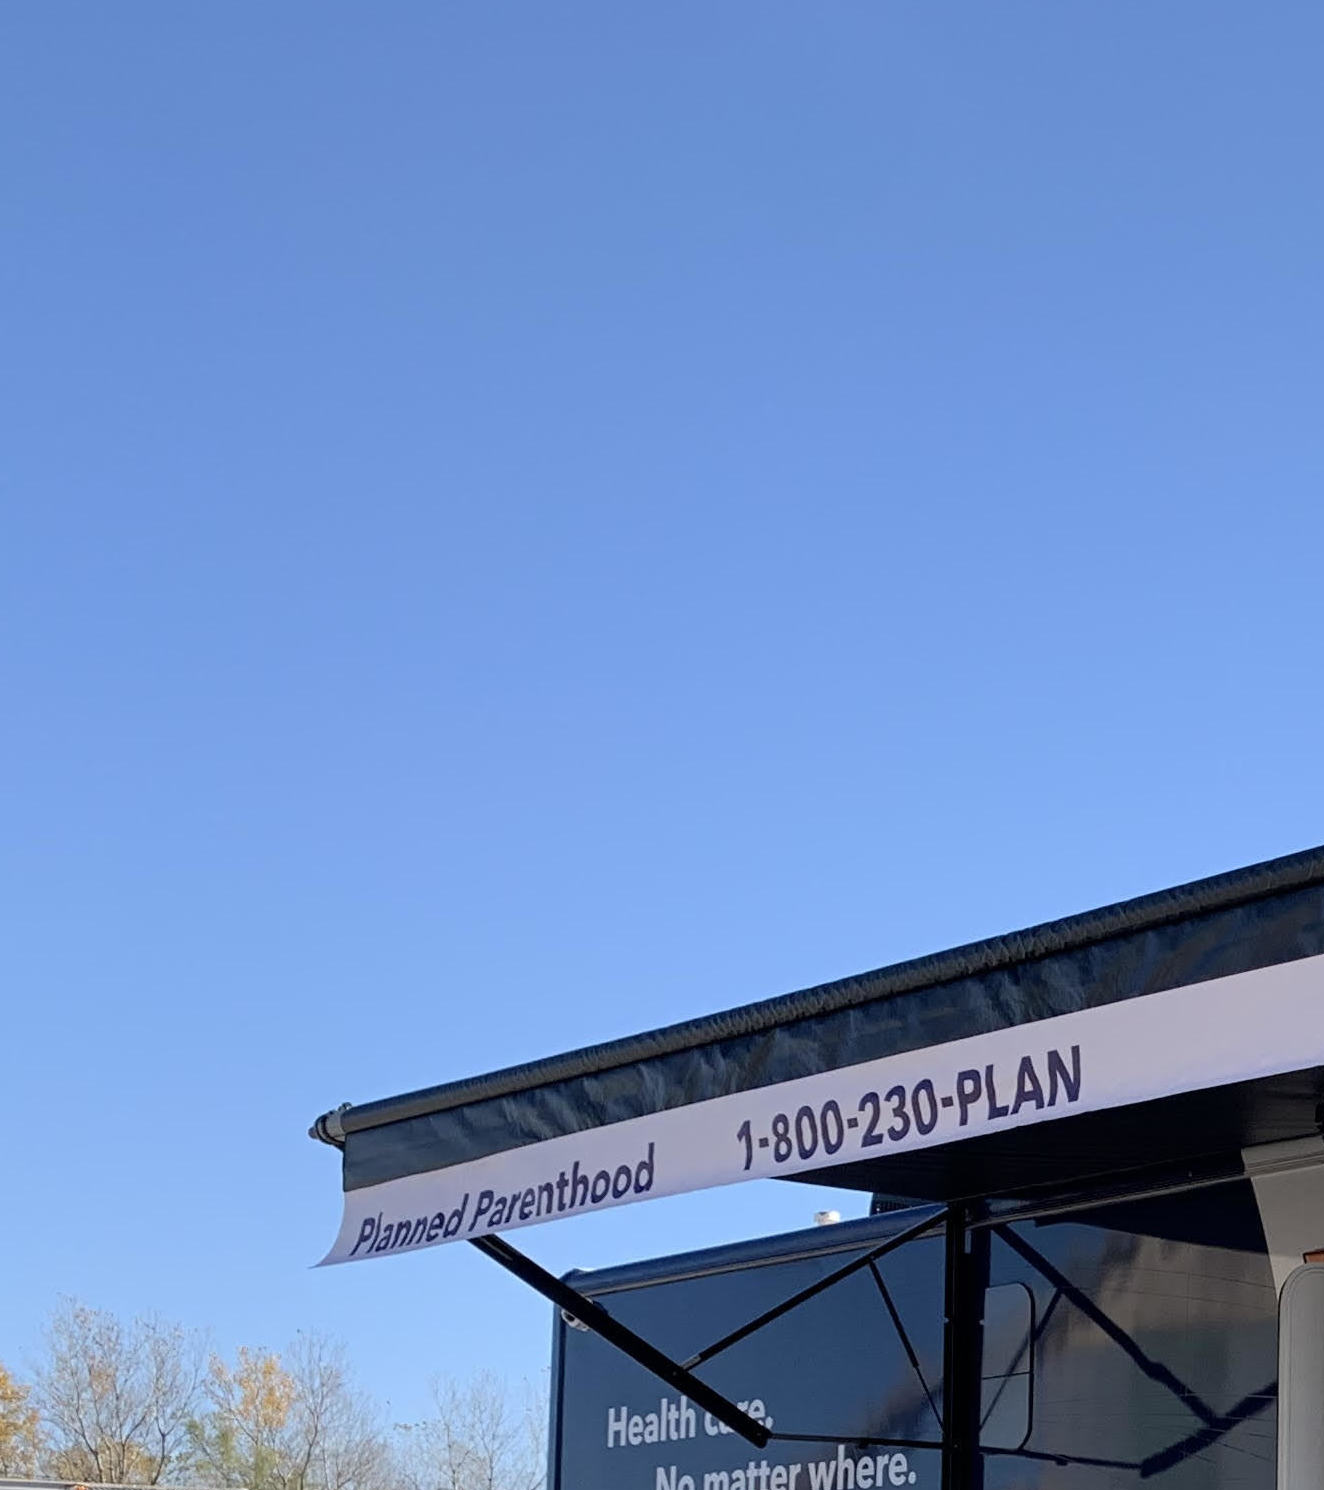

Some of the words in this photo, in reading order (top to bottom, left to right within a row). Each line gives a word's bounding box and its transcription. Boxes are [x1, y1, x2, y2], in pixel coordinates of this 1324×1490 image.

[736, 1045, 1081, 1170] 1-800-230-PLAN
[350, 1193, 470, 1256] Planned
[468, 1142, 655, 1231] Parenthood
[607, 1395, 696, 1448] Health
